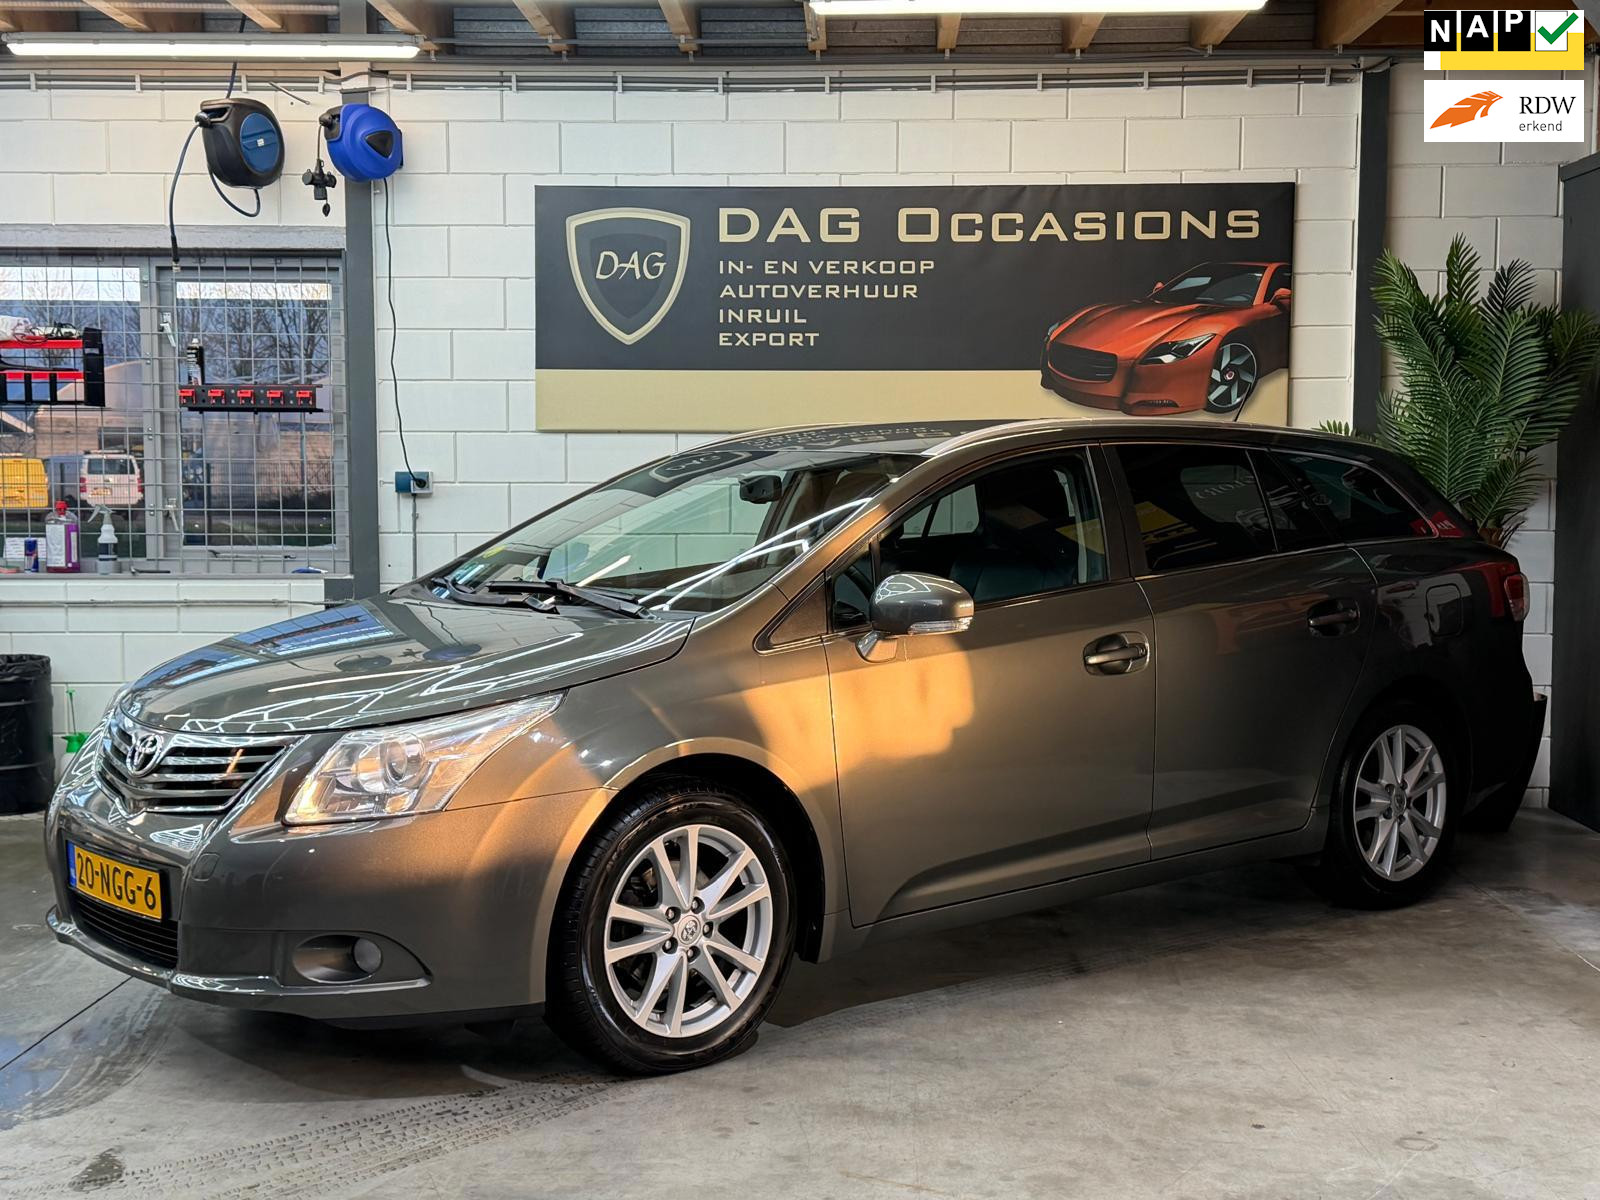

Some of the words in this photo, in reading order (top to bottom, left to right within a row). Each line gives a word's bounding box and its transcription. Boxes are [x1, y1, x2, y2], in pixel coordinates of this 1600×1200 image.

[718, 207, 860, 243] DAG
[897, 207, 1261, 243] OCCASIONS
[594, 250, 667, 281] DAG
[719, 260, 754, 275] IN-
[764, 260, 798, 275] EN
[808, 260, 935, 275] VERKOOP
[719, 284, 918, 299] AUTOVERHUUR
[719, 308, 808, 324] INRUIL
[719, 332, 820, 347] EXPORT
[76, 852, 157, 911] 20-NGG-6
